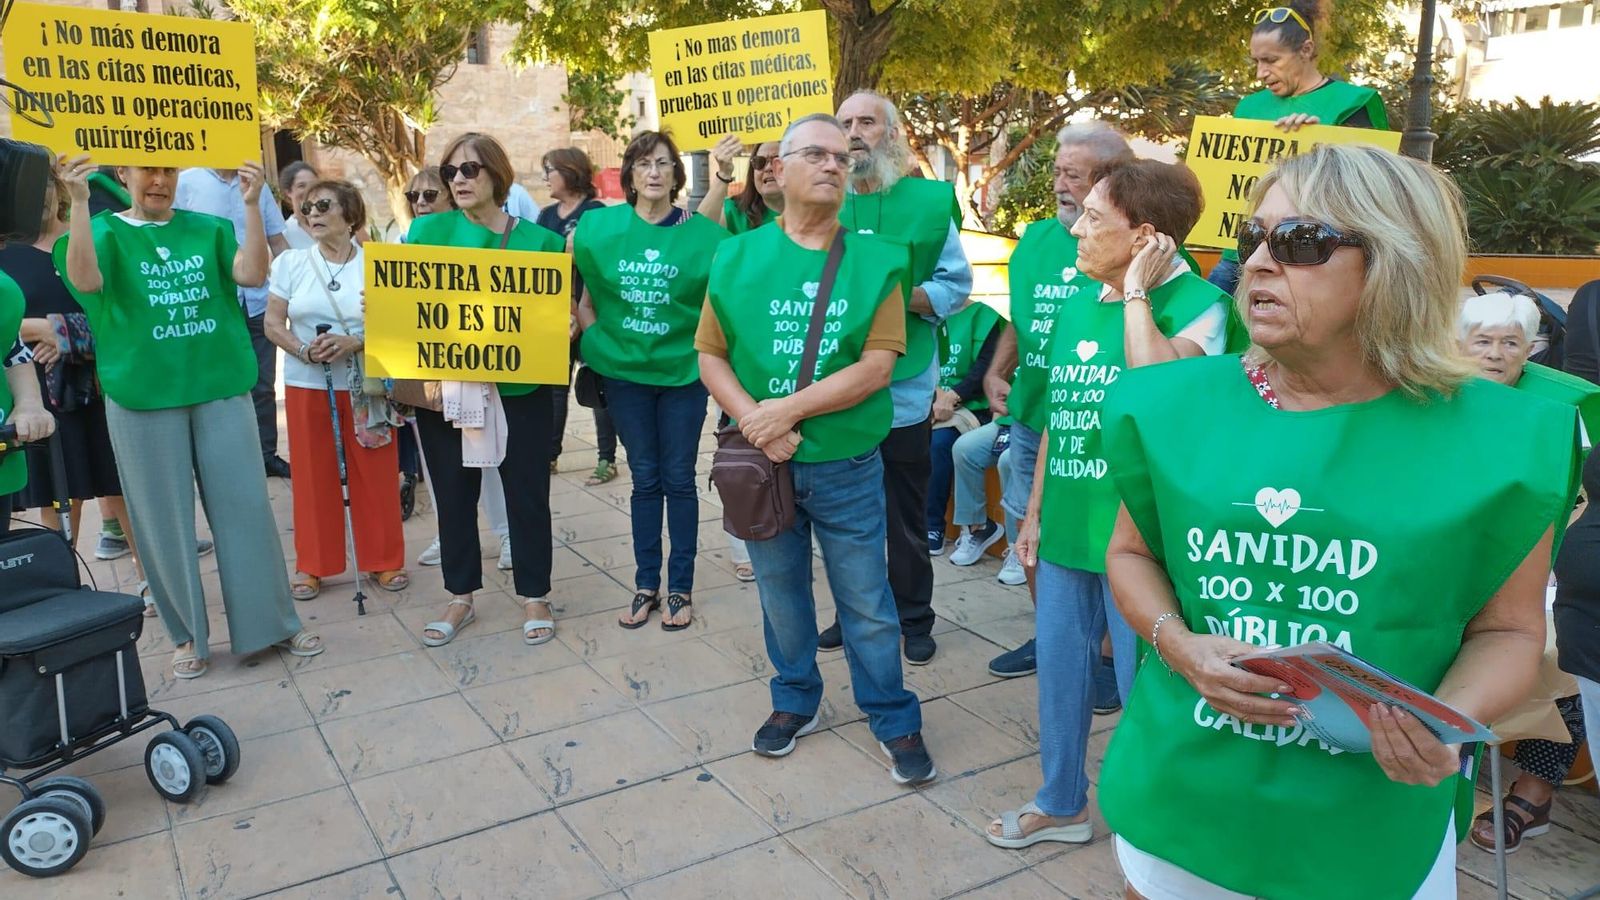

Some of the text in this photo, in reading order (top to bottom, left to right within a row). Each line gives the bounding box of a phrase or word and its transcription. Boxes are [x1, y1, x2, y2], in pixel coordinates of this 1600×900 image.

[54, 20, 82, 45] No
[91, 23, 134, 49] más
[142, 27, 220, 55] demora
[685, 38, 702, 58] No
[708, 35, 736, 54] mas
[742, 26, 800, 49] demora
[23, 55, 240, 92] en las citas medicas,
[665, 52, 816, 86] en las citas médicas,
[14, 90, 254, 121] pruebas u operaciones
[660, 78, 828, 117] pruebas u operaciones
[698, 110, 782, 138] quirurgicas
[75, 124, 194, 152] quirúrgicas
[1196, 132, 1298, 164] NUESTRA
[140, 255, 204, 277] SANIDAD
[618, 260, 678, 278] SANIDAD
[147, 280, 170, 290] 100
[182, 272, 205, 284] 100
[374, 260, 562, 295] NUESTRA SALUD
[620, 276, 639, 286] 100
[148, 286, 210, 307] PÚBLICA
[1033, 284, 1080, 299] SANID
[168, 306, 198, 320] Y DE
[416, 302, 522, 333] NO ES UN
[643, 307, 656, 318] DE
[769, 299, 848, 316] SANIAD
[1034, 304, 1055, 313] 100
[152, 318, 216, 340] CALIDAD
[622, 316, 670, 336] CALIDAD
[774, 320, 799, 332] 100
[824, 321, 841, 333] 00
[773, 335, 838, 355] PÚBCA
[1040, 338, 1048, 350] Y
[416, 342, 520, 372] NEGOCIO
[788, 360, 798, 374] Y
[1050, 365, 1121, 386] SANIDAD
[1051, 389, 1066, 402] 100
[1083, 389, 1104, 402] 100
[1050, 407, 1100, 430] PÚBLICA
[1058, 436, 1085, 454] Y DE
[1050, 458, 1107, 480] CALIDAD
[0, 553, 34, 570] LETT
[1187, 528, 1378, 580] SANIDAD
[1198, 576, 1252, 601] 100
[1298, 586, 1359, 616] 100
